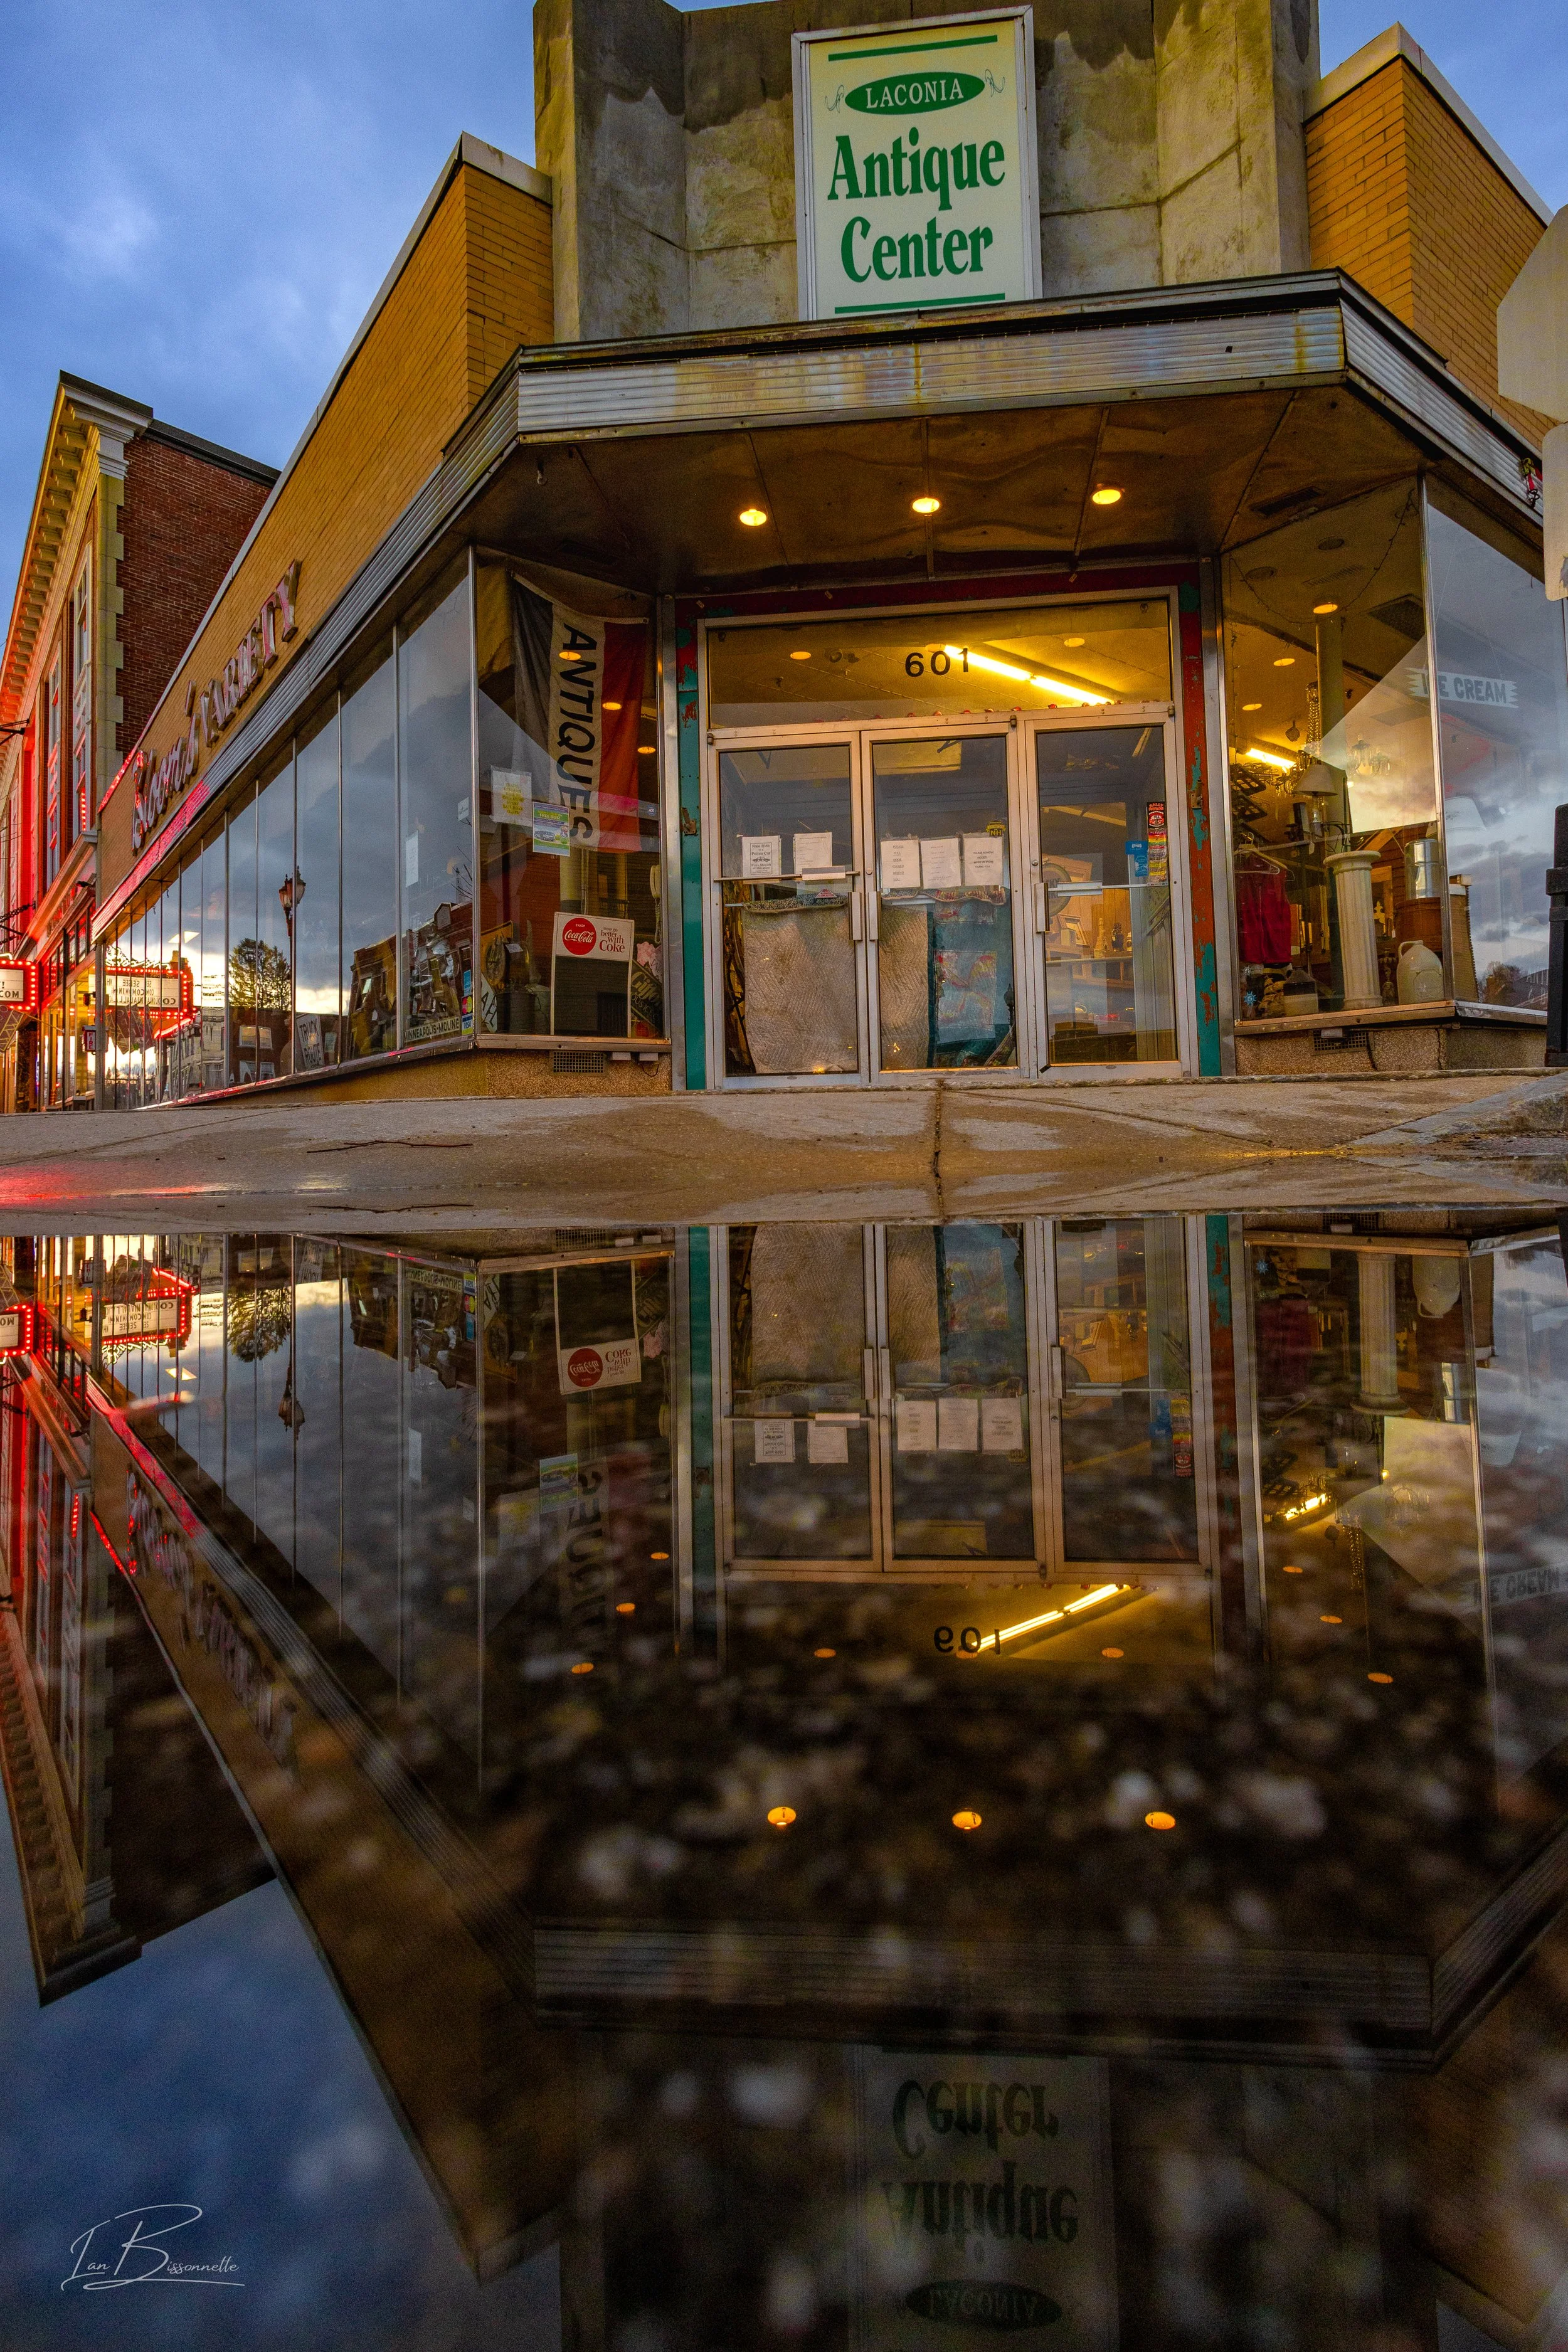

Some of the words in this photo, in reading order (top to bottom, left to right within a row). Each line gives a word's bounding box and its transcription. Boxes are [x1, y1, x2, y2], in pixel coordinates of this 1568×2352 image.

[866, 78, 965, 109] LACONIA
[827, 127, 1005, 211] Antique
[841, 216, 993, 283] Center
[199, 559, 302, 748] VARIETY
[905, 648, 968, 677] 601
[1453, 677, 1507, 703] CREAM
[556, 622, 598, 839] ANTIQUES
[599, 940, 625, 953] Coke
[601, 929, 618, 937] better
[608, 935, 624, 944] with
[404, 1017, 460, 1041] MINNEAPOLIS-MOLINE
